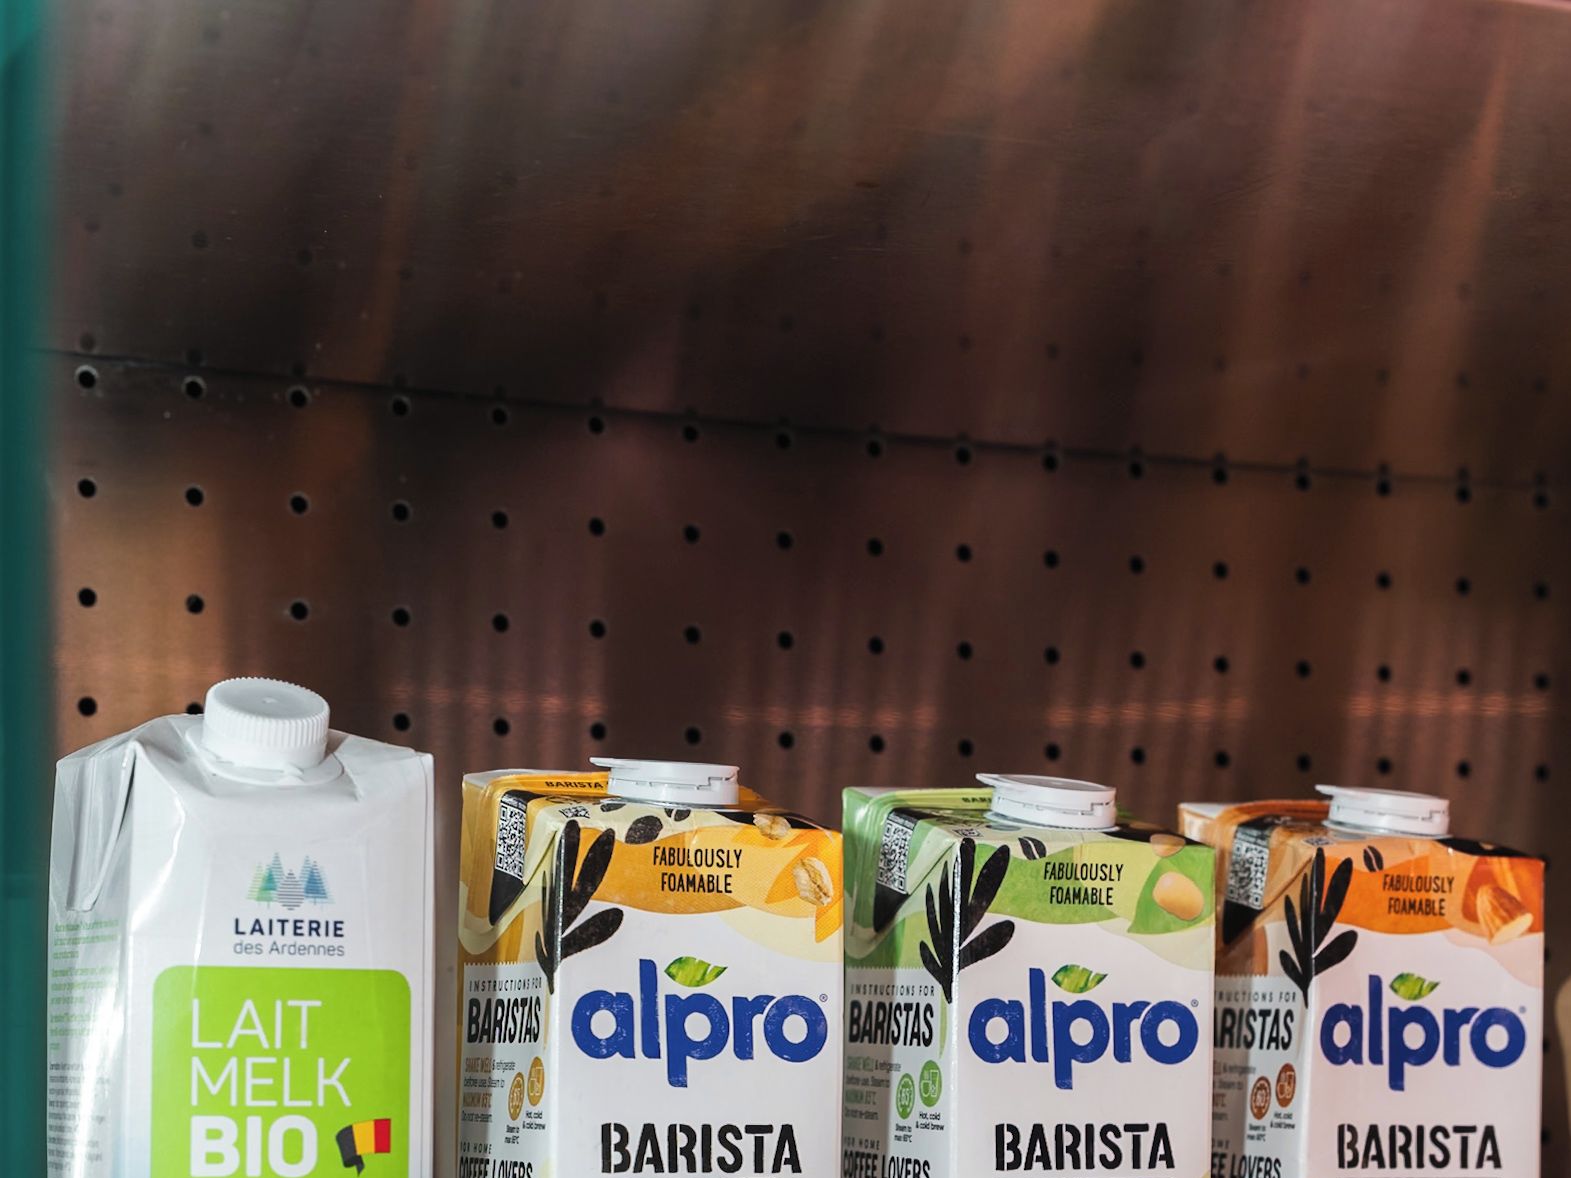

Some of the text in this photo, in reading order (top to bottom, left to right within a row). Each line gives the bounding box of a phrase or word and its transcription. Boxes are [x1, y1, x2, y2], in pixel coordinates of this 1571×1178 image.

[653, 846, 742, 869] FABULOUSLY
[1044, 862, 1122, 882] FABULOUSLY
[661, 873, 732, 894] FOAMABLE
[1383, 875, 1454, 894] FABULOUSLY
[1050, 887, 1113, 906] FOAMABLE
[1388, 899, 1446, 916] FOAMABLE
[234, 917, 344, 938] LAITERIE
[234, 941, 344, 957] des Ardennes
[470, 978, 530, 992] INSTRUCTIONS
[850, 984, 934, 996] INSTRUCTIONS FOR
[1217, 991, 1296, 1003] RUCTIONS FOR
[192, 998, 322, 1049] LAIT
[466, 996, 540, 1044] BARISTAS
[571, 959, 828, 1088] alpro
[849, 999, 934, 1047] BARISTAS
[968, 968, 1198, 1089] alpro
[1320, 974, 1526, 1092] alpro
[192, 1057, 352, 1107] MELK
[919, 1112, 940, 1120] Hot, cold
[190, 1115, 317, 1178] BIO
[474, 1143, 492, 1154] HOME
[601, 1123, 802, 1174] BARISTA
[858, 1138, 880, 1149] HOME
[995, 1123, 1175, 1171] BARISTA
[1338, 1124, 1503, 1170] BARISTA
